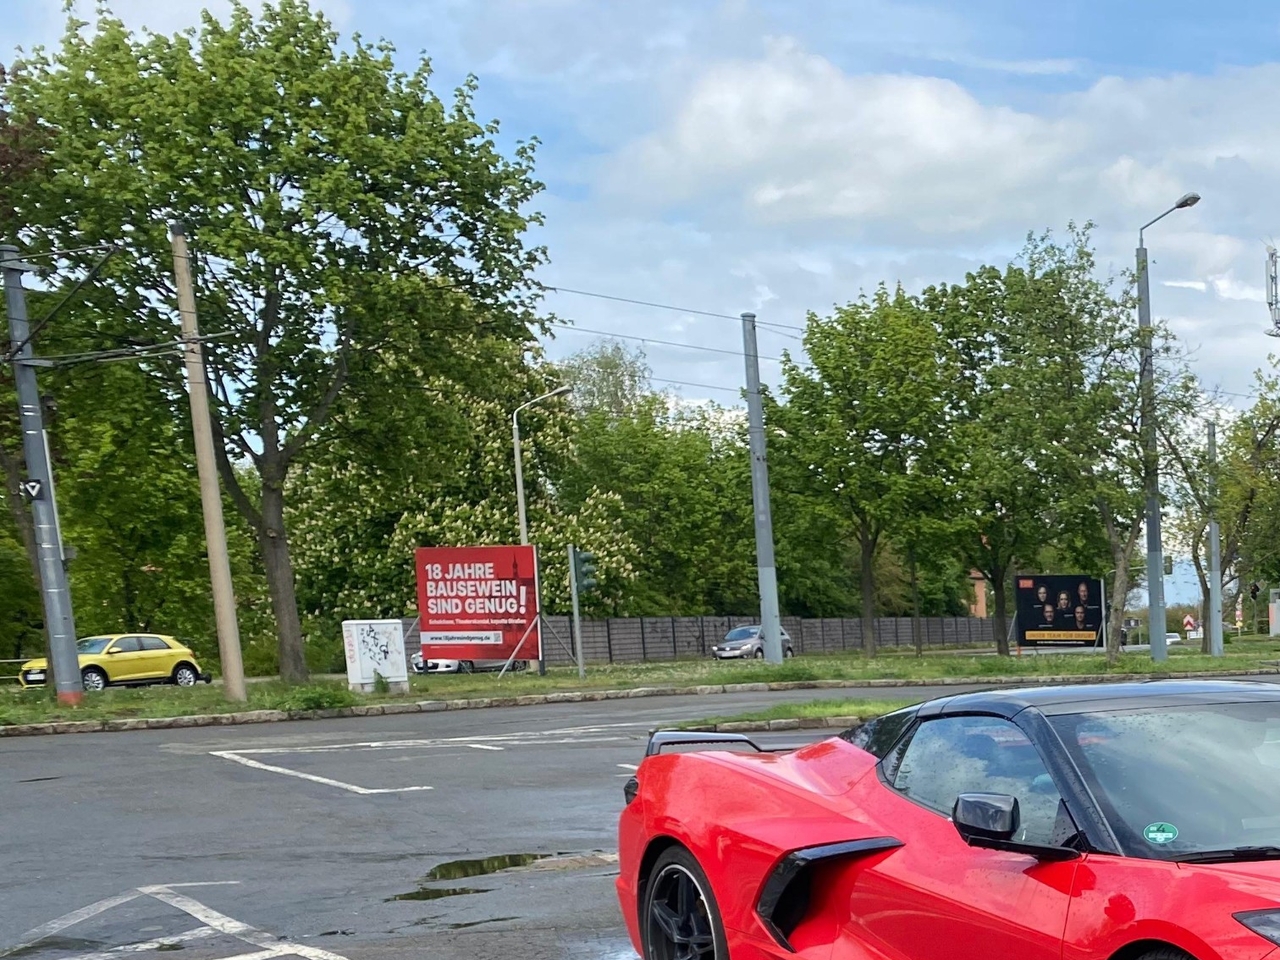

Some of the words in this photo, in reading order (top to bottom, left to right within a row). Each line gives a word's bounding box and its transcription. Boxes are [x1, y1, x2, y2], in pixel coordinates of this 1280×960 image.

[425, 563, 442, 579] 18
[444, 562, 495, 579] JAHRE
[426, 580, 517, 597] BAUSEWEIN
[427, 598, 462, 614] SIND
[1157, 824, 1165, 833] 4
